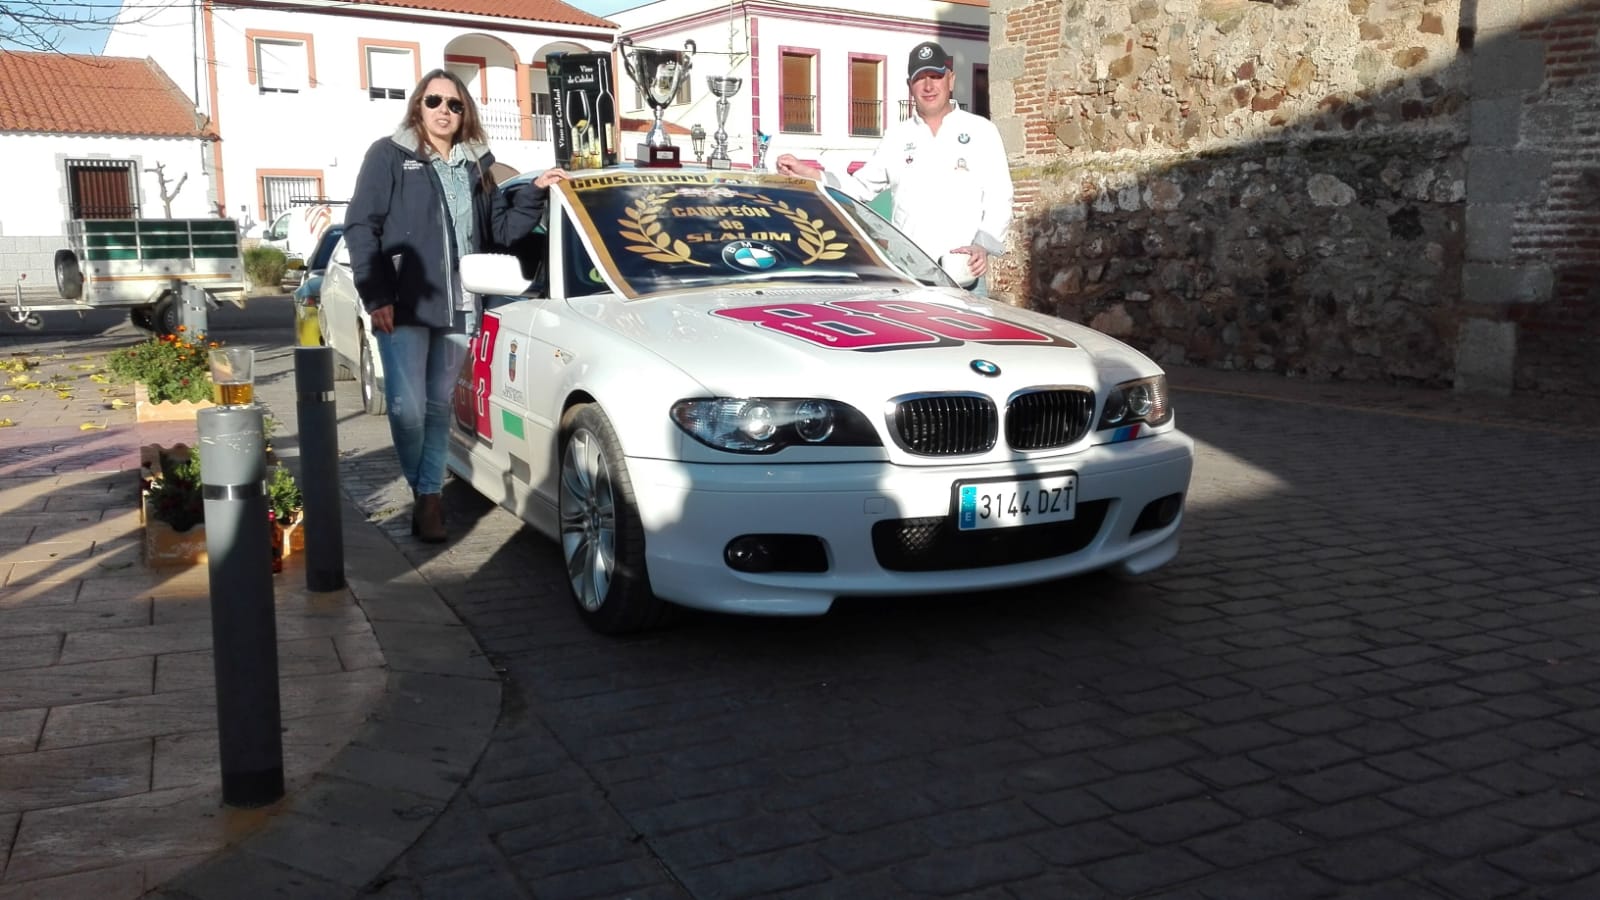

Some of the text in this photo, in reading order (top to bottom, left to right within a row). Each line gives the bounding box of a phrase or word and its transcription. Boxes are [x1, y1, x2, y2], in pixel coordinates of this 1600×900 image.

[574, 74, 594, 83] Calidad
[553, 88, 562, 117] Calidad
[671, 205, 771, 218] CAMPEÓN
[719, 219, 745, 230] de
[686, 232, 791, 243] SLALOM
[726, 241, 775, 254] BMW
[979, 486, 1073, 519] 3144 DZT
[965, 512, 972, 522] E
